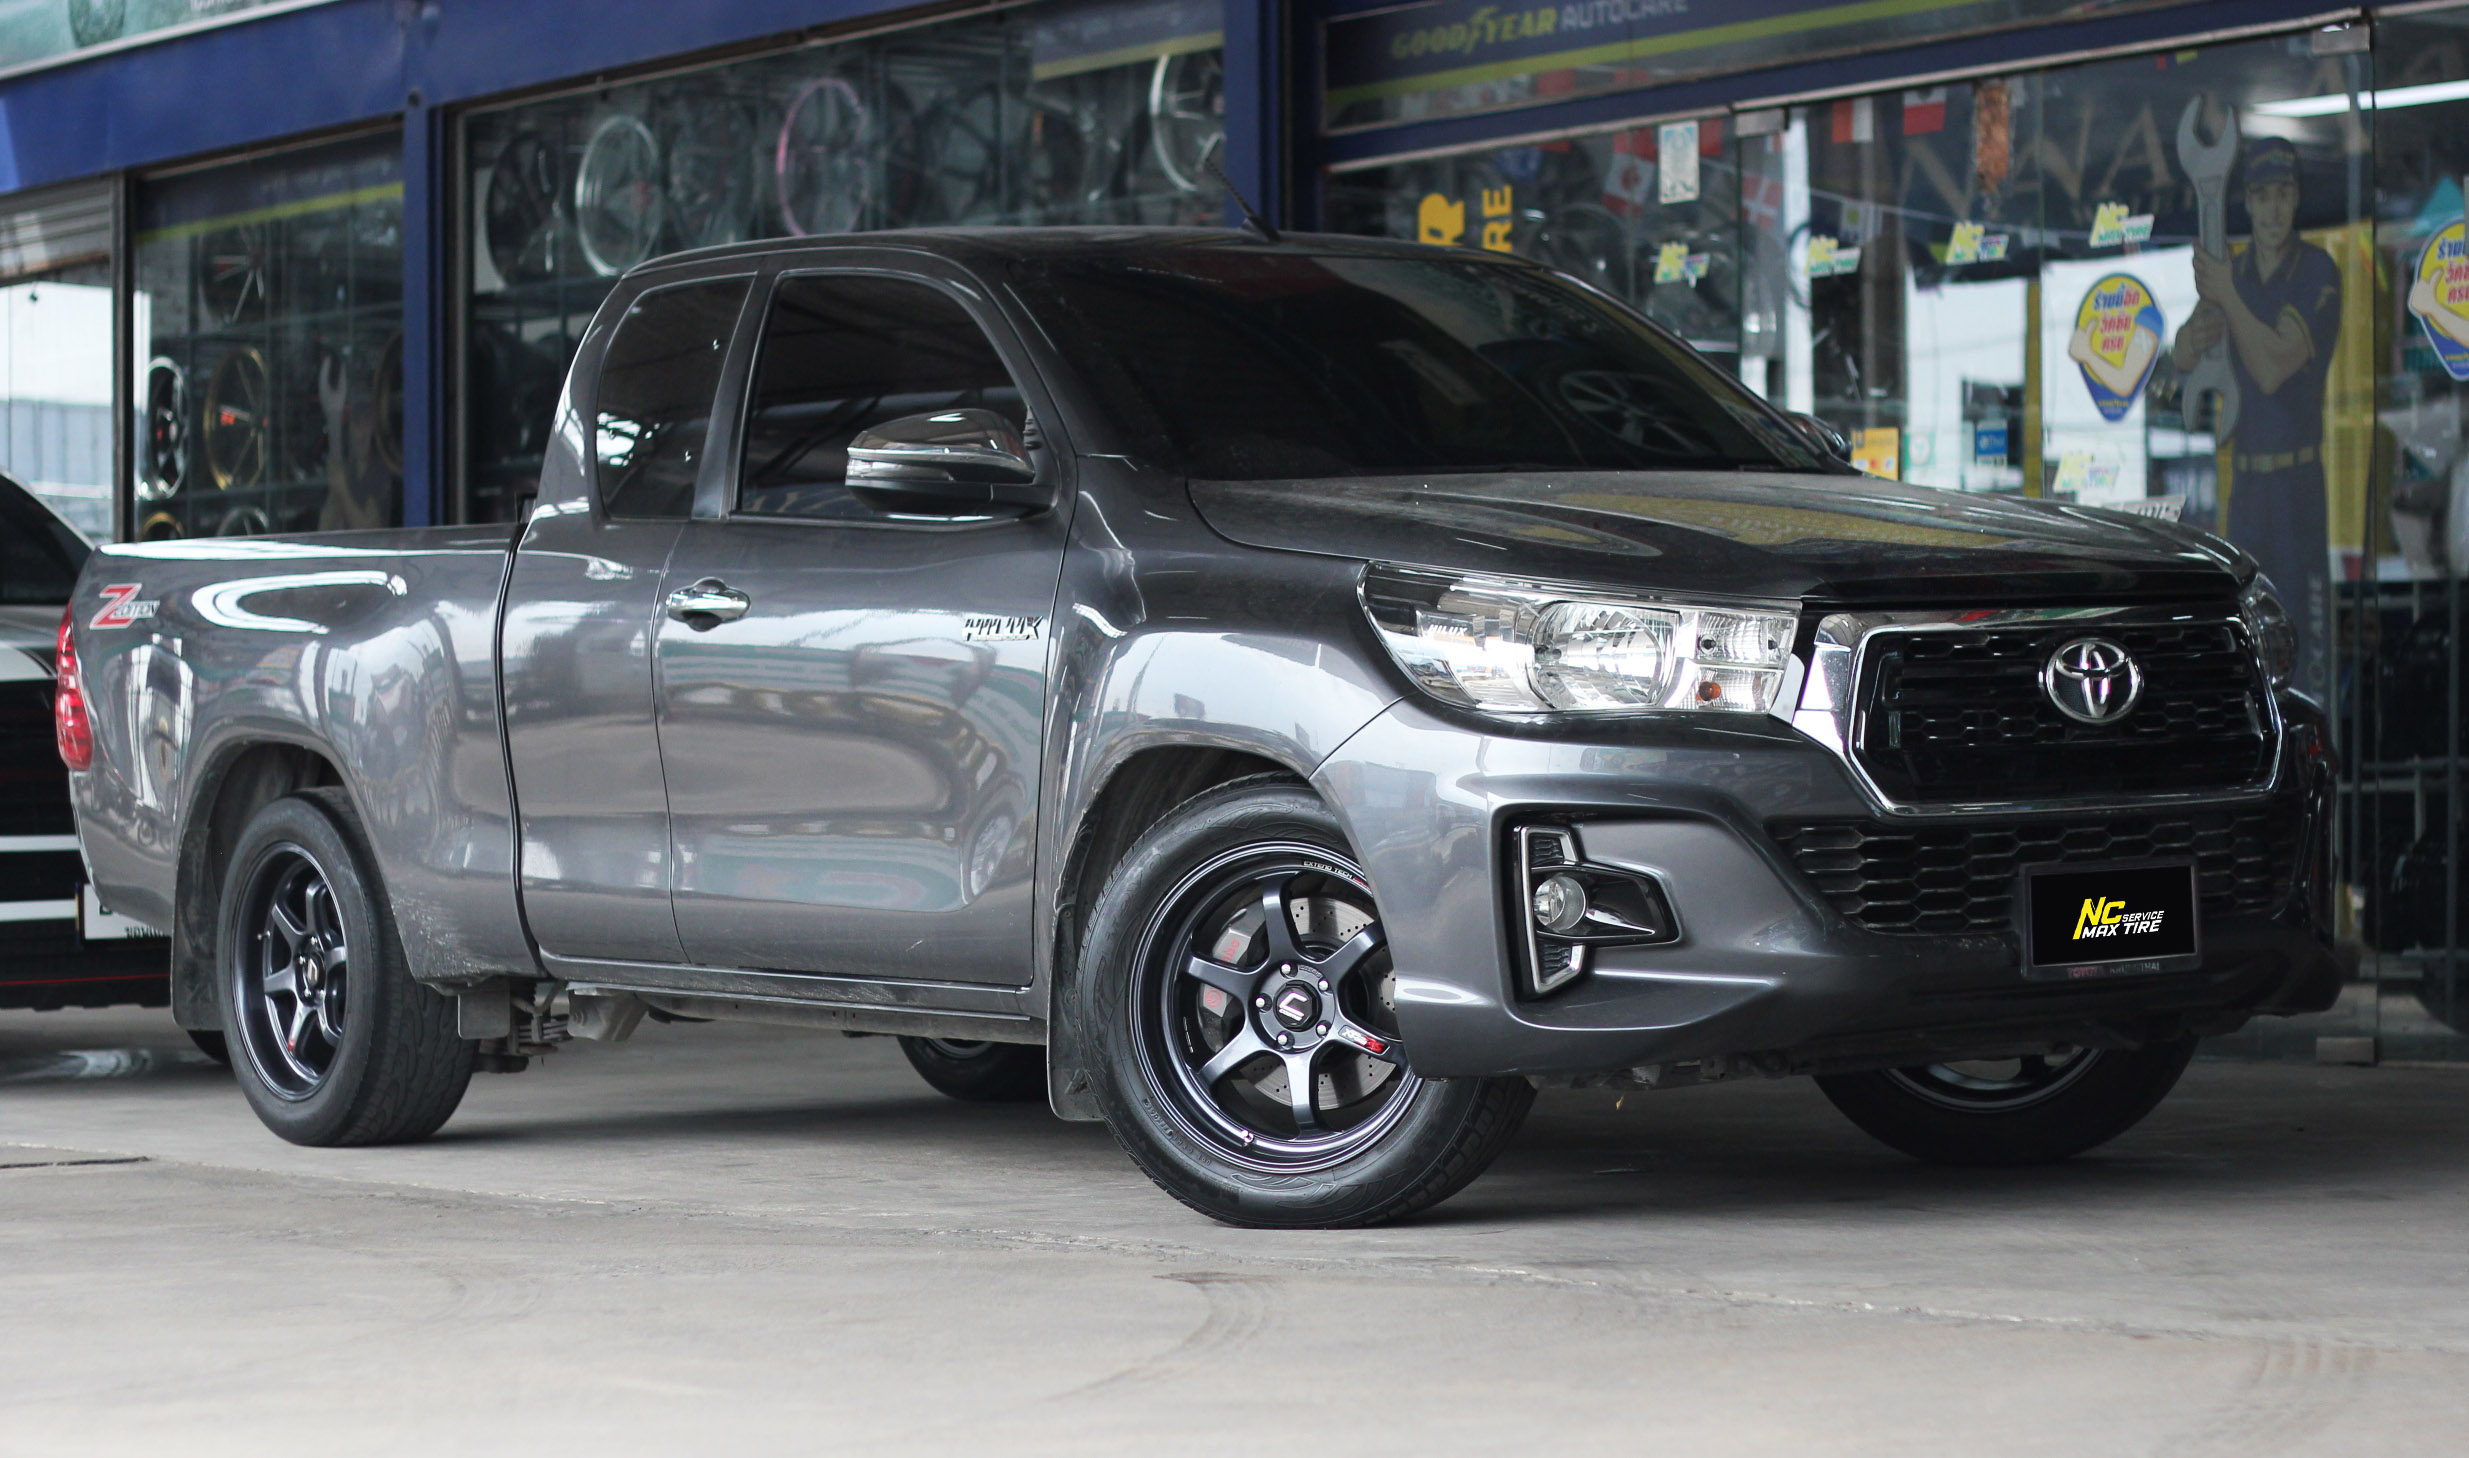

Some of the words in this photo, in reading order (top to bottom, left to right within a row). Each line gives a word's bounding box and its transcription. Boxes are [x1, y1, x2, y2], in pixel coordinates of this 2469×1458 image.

[1391, 7, 1557, 60] GOODYEAR
[2091, 202, 2129, 246] NC
[90, 582, 142, 630] Z
[1333, 867, 1353, 879] TECH
